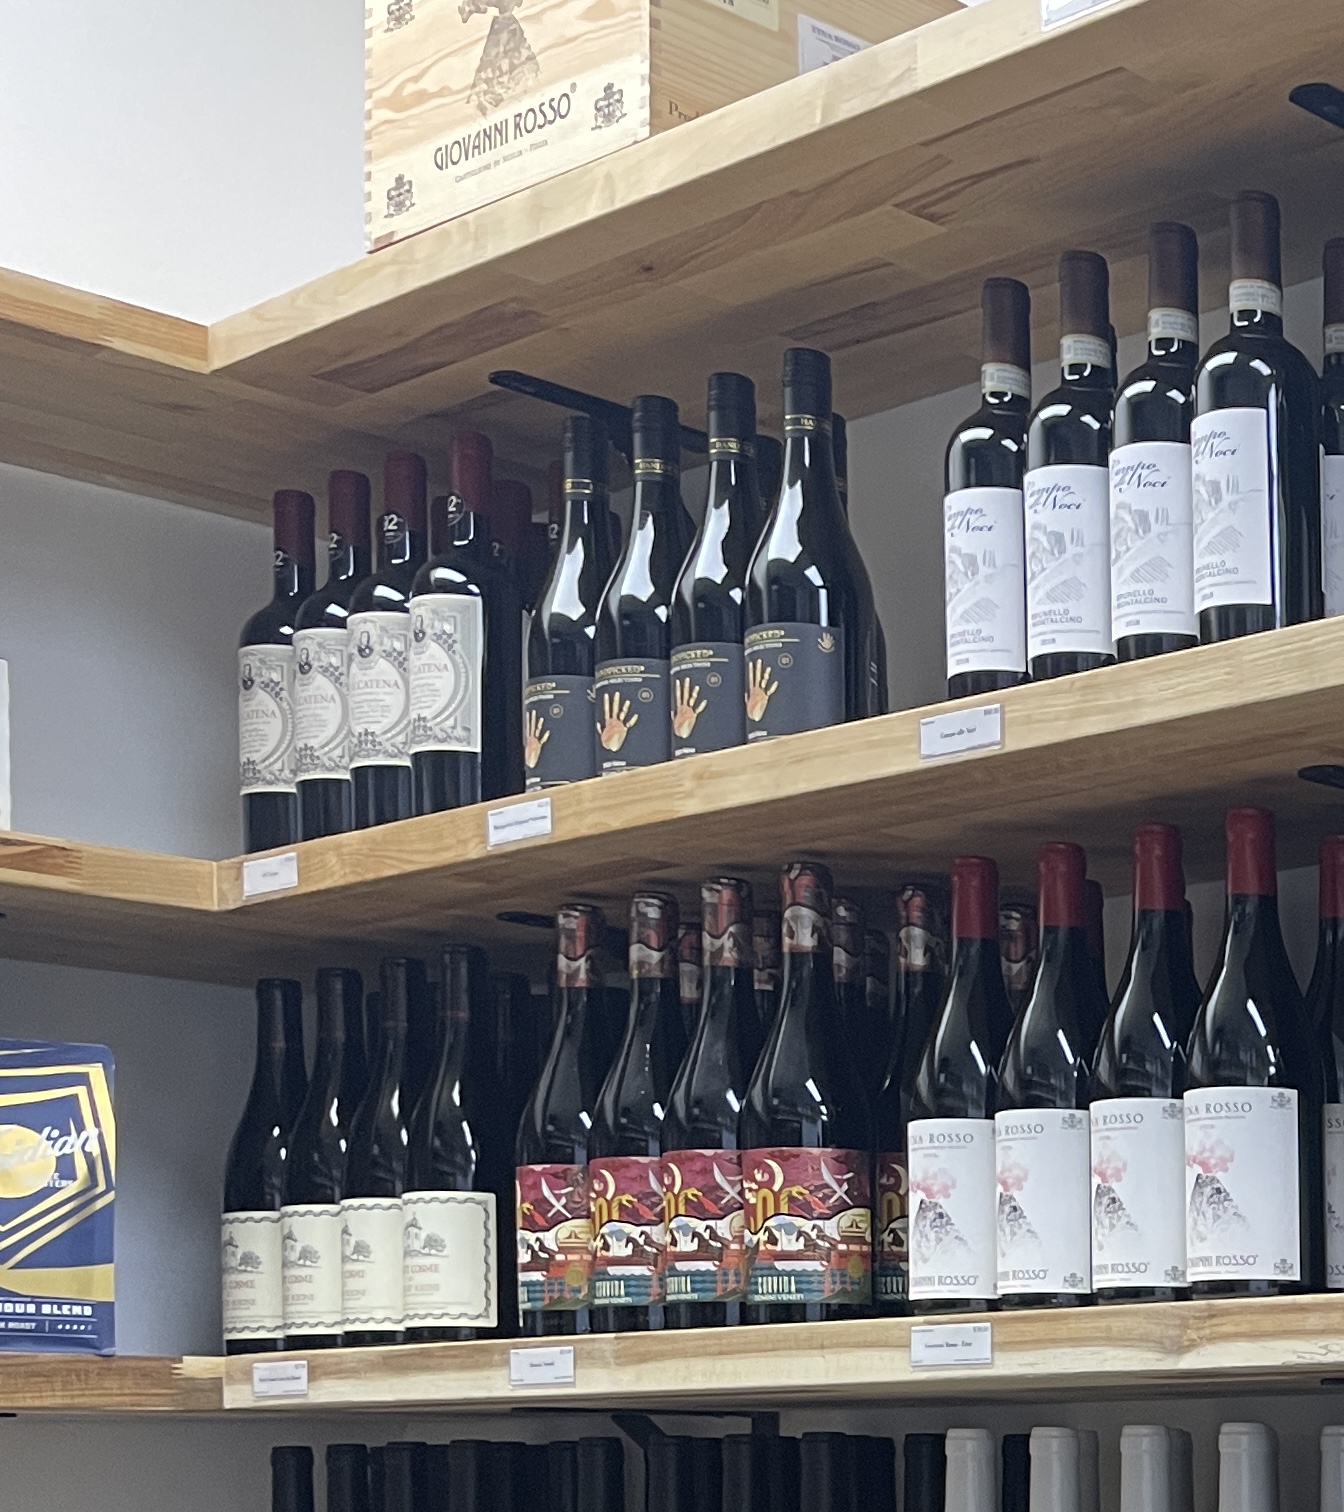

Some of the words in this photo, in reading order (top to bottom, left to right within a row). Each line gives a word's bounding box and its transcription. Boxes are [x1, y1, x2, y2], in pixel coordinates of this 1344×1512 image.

[433, 117, 509, 171] GIOVANNI
[513, 92, 571, 139] ROSSO
[1103, 1113, 1143, 1125] ROSSO
[1005, 1124, 1044, 1135] ROSSO
[1216, 1255, 1254, 1266] ROSSO
